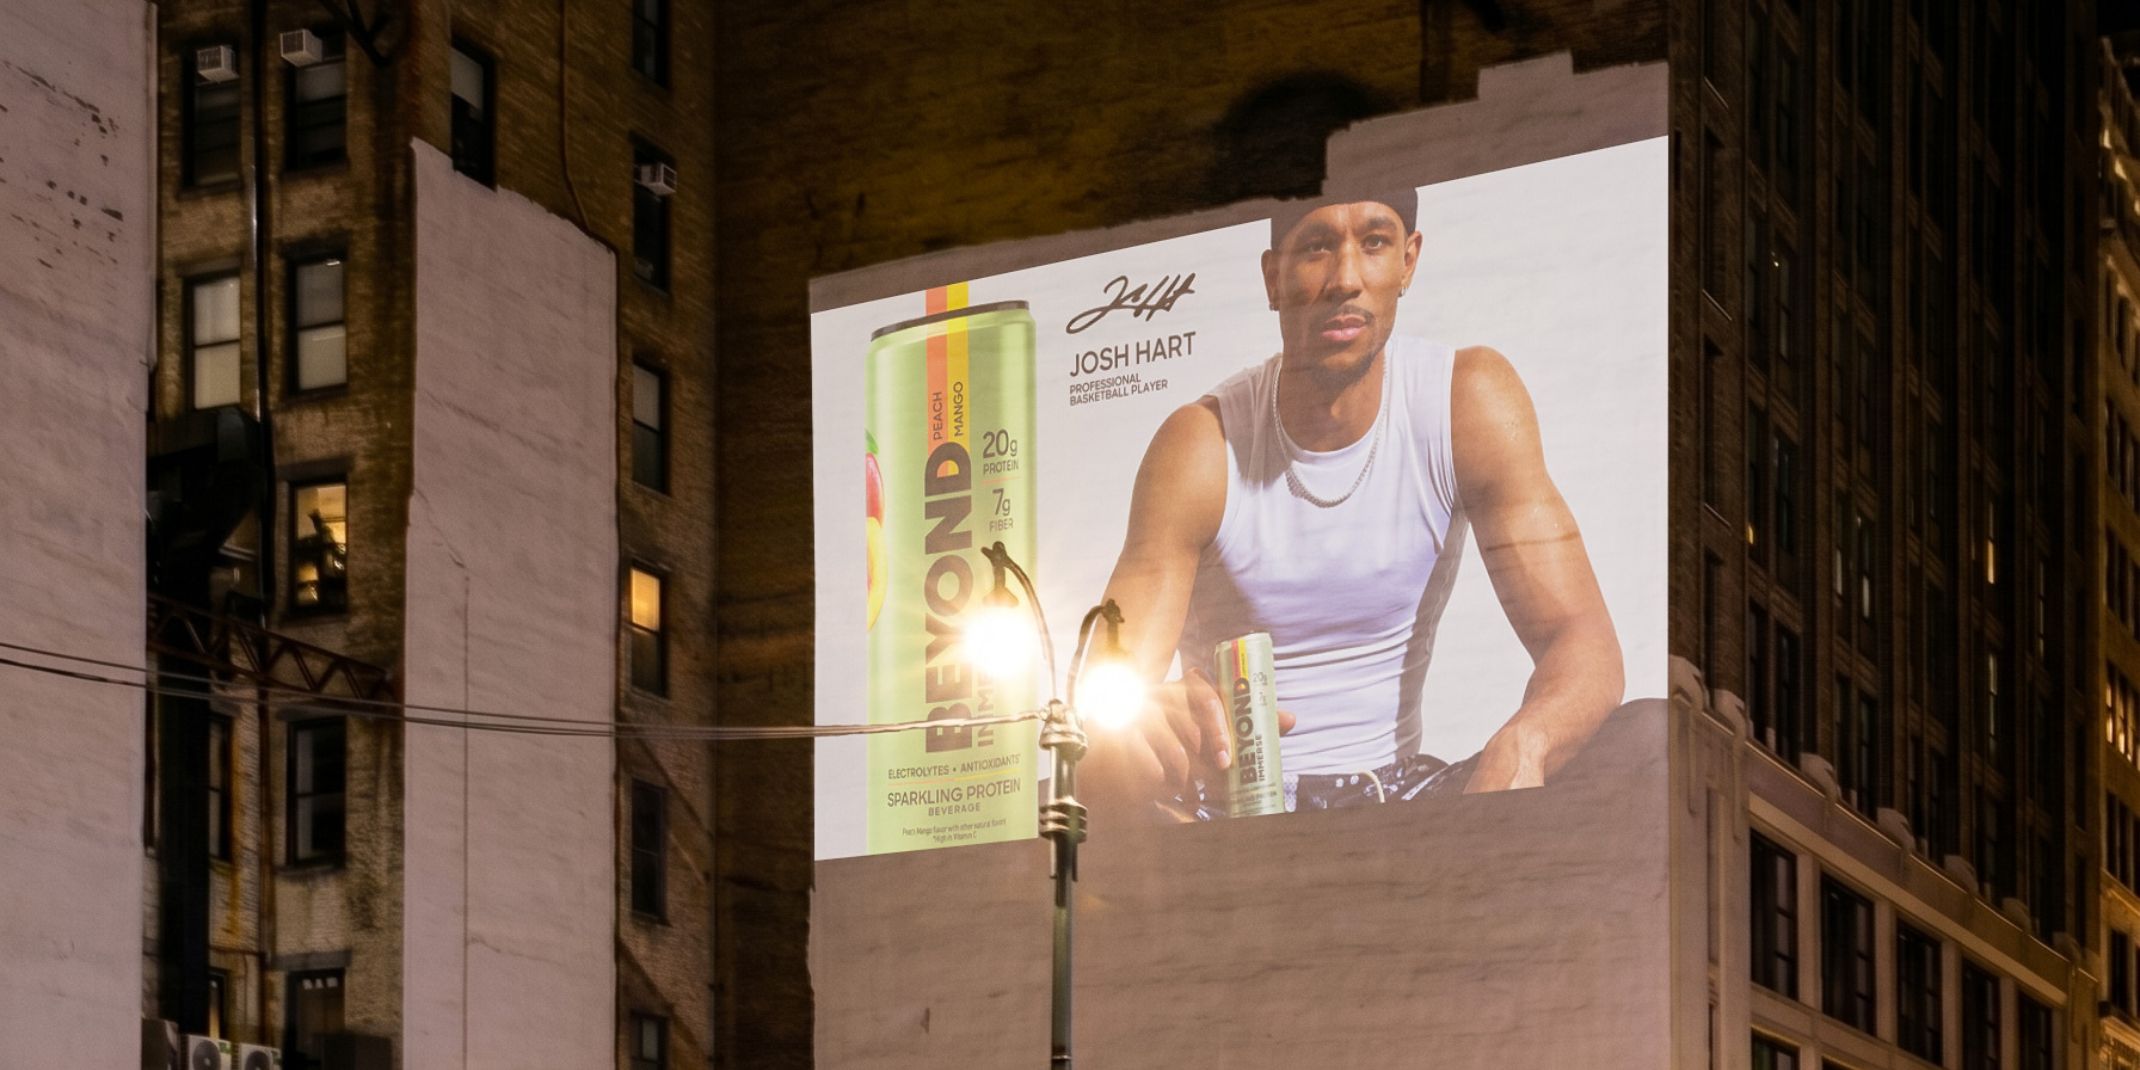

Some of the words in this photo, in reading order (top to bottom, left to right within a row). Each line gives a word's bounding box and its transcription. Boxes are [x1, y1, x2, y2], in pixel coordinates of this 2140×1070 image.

[1070, 343, 1129, 377] JOSH
[1136, 331, 1196, 365] HART
[1069, 373, 1141, 394] PROFESSIONAL
[1069, 386, 1129, 406] BASKETBALL
[1131, 379, 1168, 395] PLAYER
[932, 391, 943, 440] PEACH
[952, 381, 964, 437] MANGO
[982, 429, 1018, 458] 20g
[983, 460, 1019, 475] PROTEIN
[992, 488, 1011, 516] 7g
[989, 518, 1014, 532] FIBER
[924, 441, 974, 753] BEYOND
[1233, 677, 1257, 785] BEYOND
[1255, 734, 1265, 781] IMMERSE
[888, 765, 949, 780] ELECTROLYTES
[887, 787, 963, 807] SPARKLING
[966, 778, 1021, 800] PROTEIN
[928, 802, 981, 816] BEVERAGE
